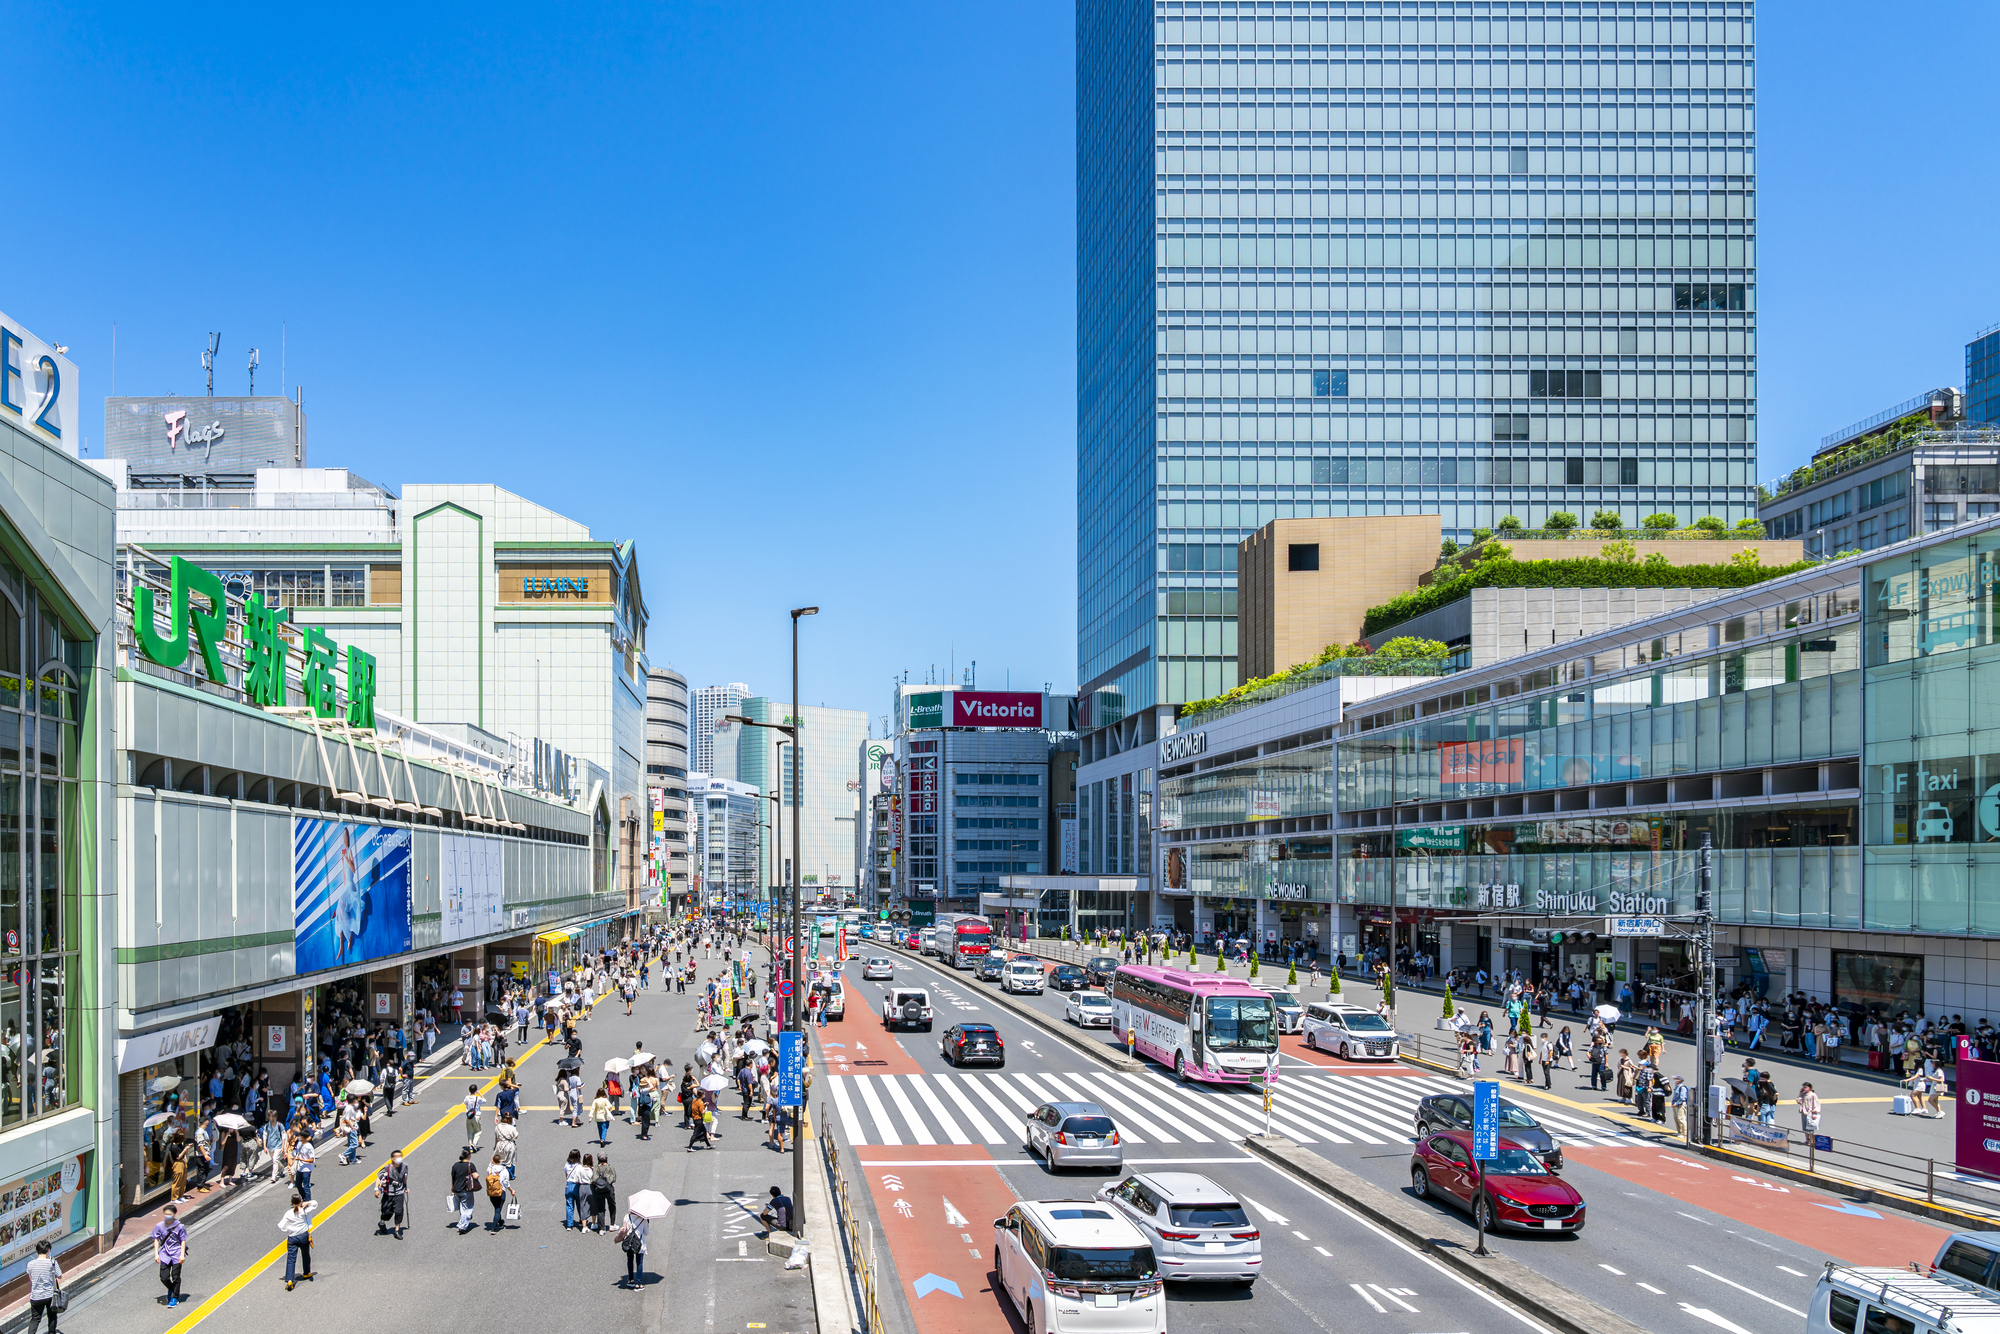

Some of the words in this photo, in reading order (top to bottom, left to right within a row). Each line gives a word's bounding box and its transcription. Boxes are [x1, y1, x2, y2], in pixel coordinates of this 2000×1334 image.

[164, 410, 225, 459] Flags
[523, 576, 589, 592] LUMINE
[1918, 570, 1978, 600] Expwy.
[134, 555, 228, 684] JR
[910, 703, 943, 714] L-Breath
[960, 700, 1035, 718] Victoria
[1161, 731, 1206, 763] NEWoMan
[924, 758, 934, 811] Victoria
[1882, 765, 1907, 794] 3F
[1917, 769, 1957, 791] Taxi
[1268, 882, 1307, 900] NEWoMan
[1450, 887, 1466, 904] JR
[1478, 883, 1521, 907] 新宿駅
[1536, 889, 1596, 912] Shinjuku
[1609, 890, 1667, 915] Station
[1617, 918, 1660, 927] 新宿駅南口
[1152, 1021, 1177, 1046] EXPRESS
[1482, 1097, 1490, 1144] バスタ新宿へは
[1475, 1124, 1483, 1157] 入れません
